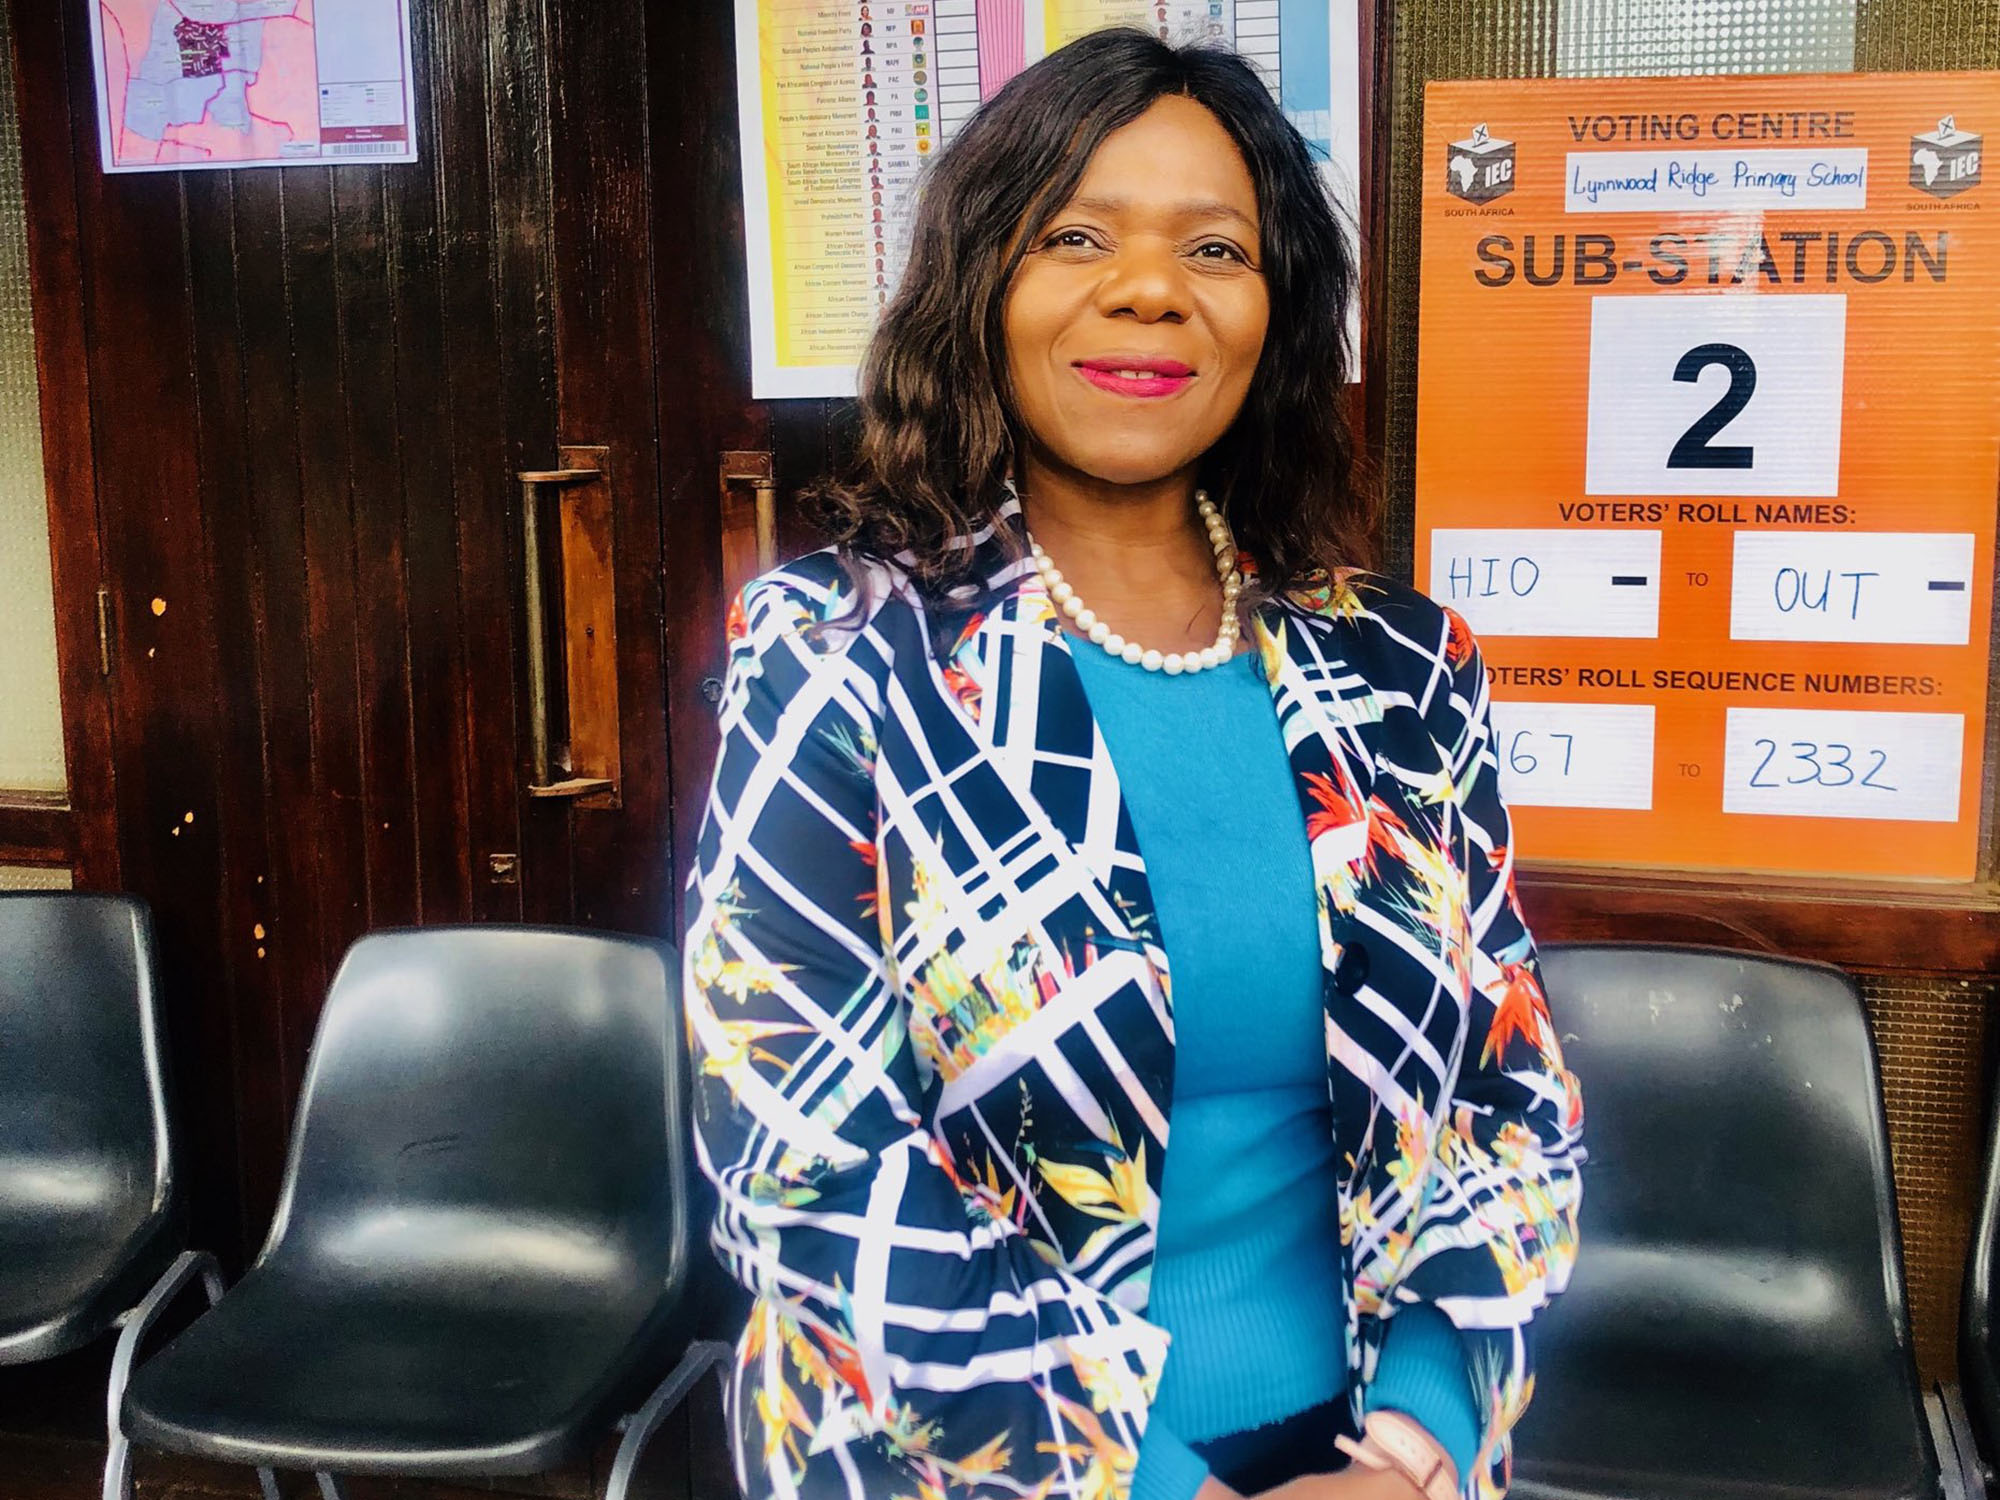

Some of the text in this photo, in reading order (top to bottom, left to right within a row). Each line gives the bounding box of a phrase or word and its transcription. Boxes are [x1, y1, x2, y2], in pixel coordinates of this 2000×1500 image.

[1568, 111, 1856, 143] VOTING CENTRE
[1484, 158, 1513, 189] IEC
[1949, 150, 1981, 180] IEC
[1573, 162, 1865, 203] Lynnwood Ridge Primary School
[1444, 207, 1516, 218] SOUTH AFRICA
[1906, 202, 1982, 212] SOUTH AFRICA
[1474, 230, 1949, 288] SUB-STATION
[1666, 342, 1758, 470] 2
[1679, 503, 1747, 523] ROLL
[1755, 504, 1857, 525] NAMES:
[1449, 556, 1540, 598] HIO
[1686, 573, 1708, 587] TO
[1774, 567, 1880, 620] OUT
[1487, 667, 1943, 696] OTERS’ ROLL SEQUENCE NUMBERS:
[1679, 763, 1700, 778] TO
[1750, 740, 1897, 792] 2332
